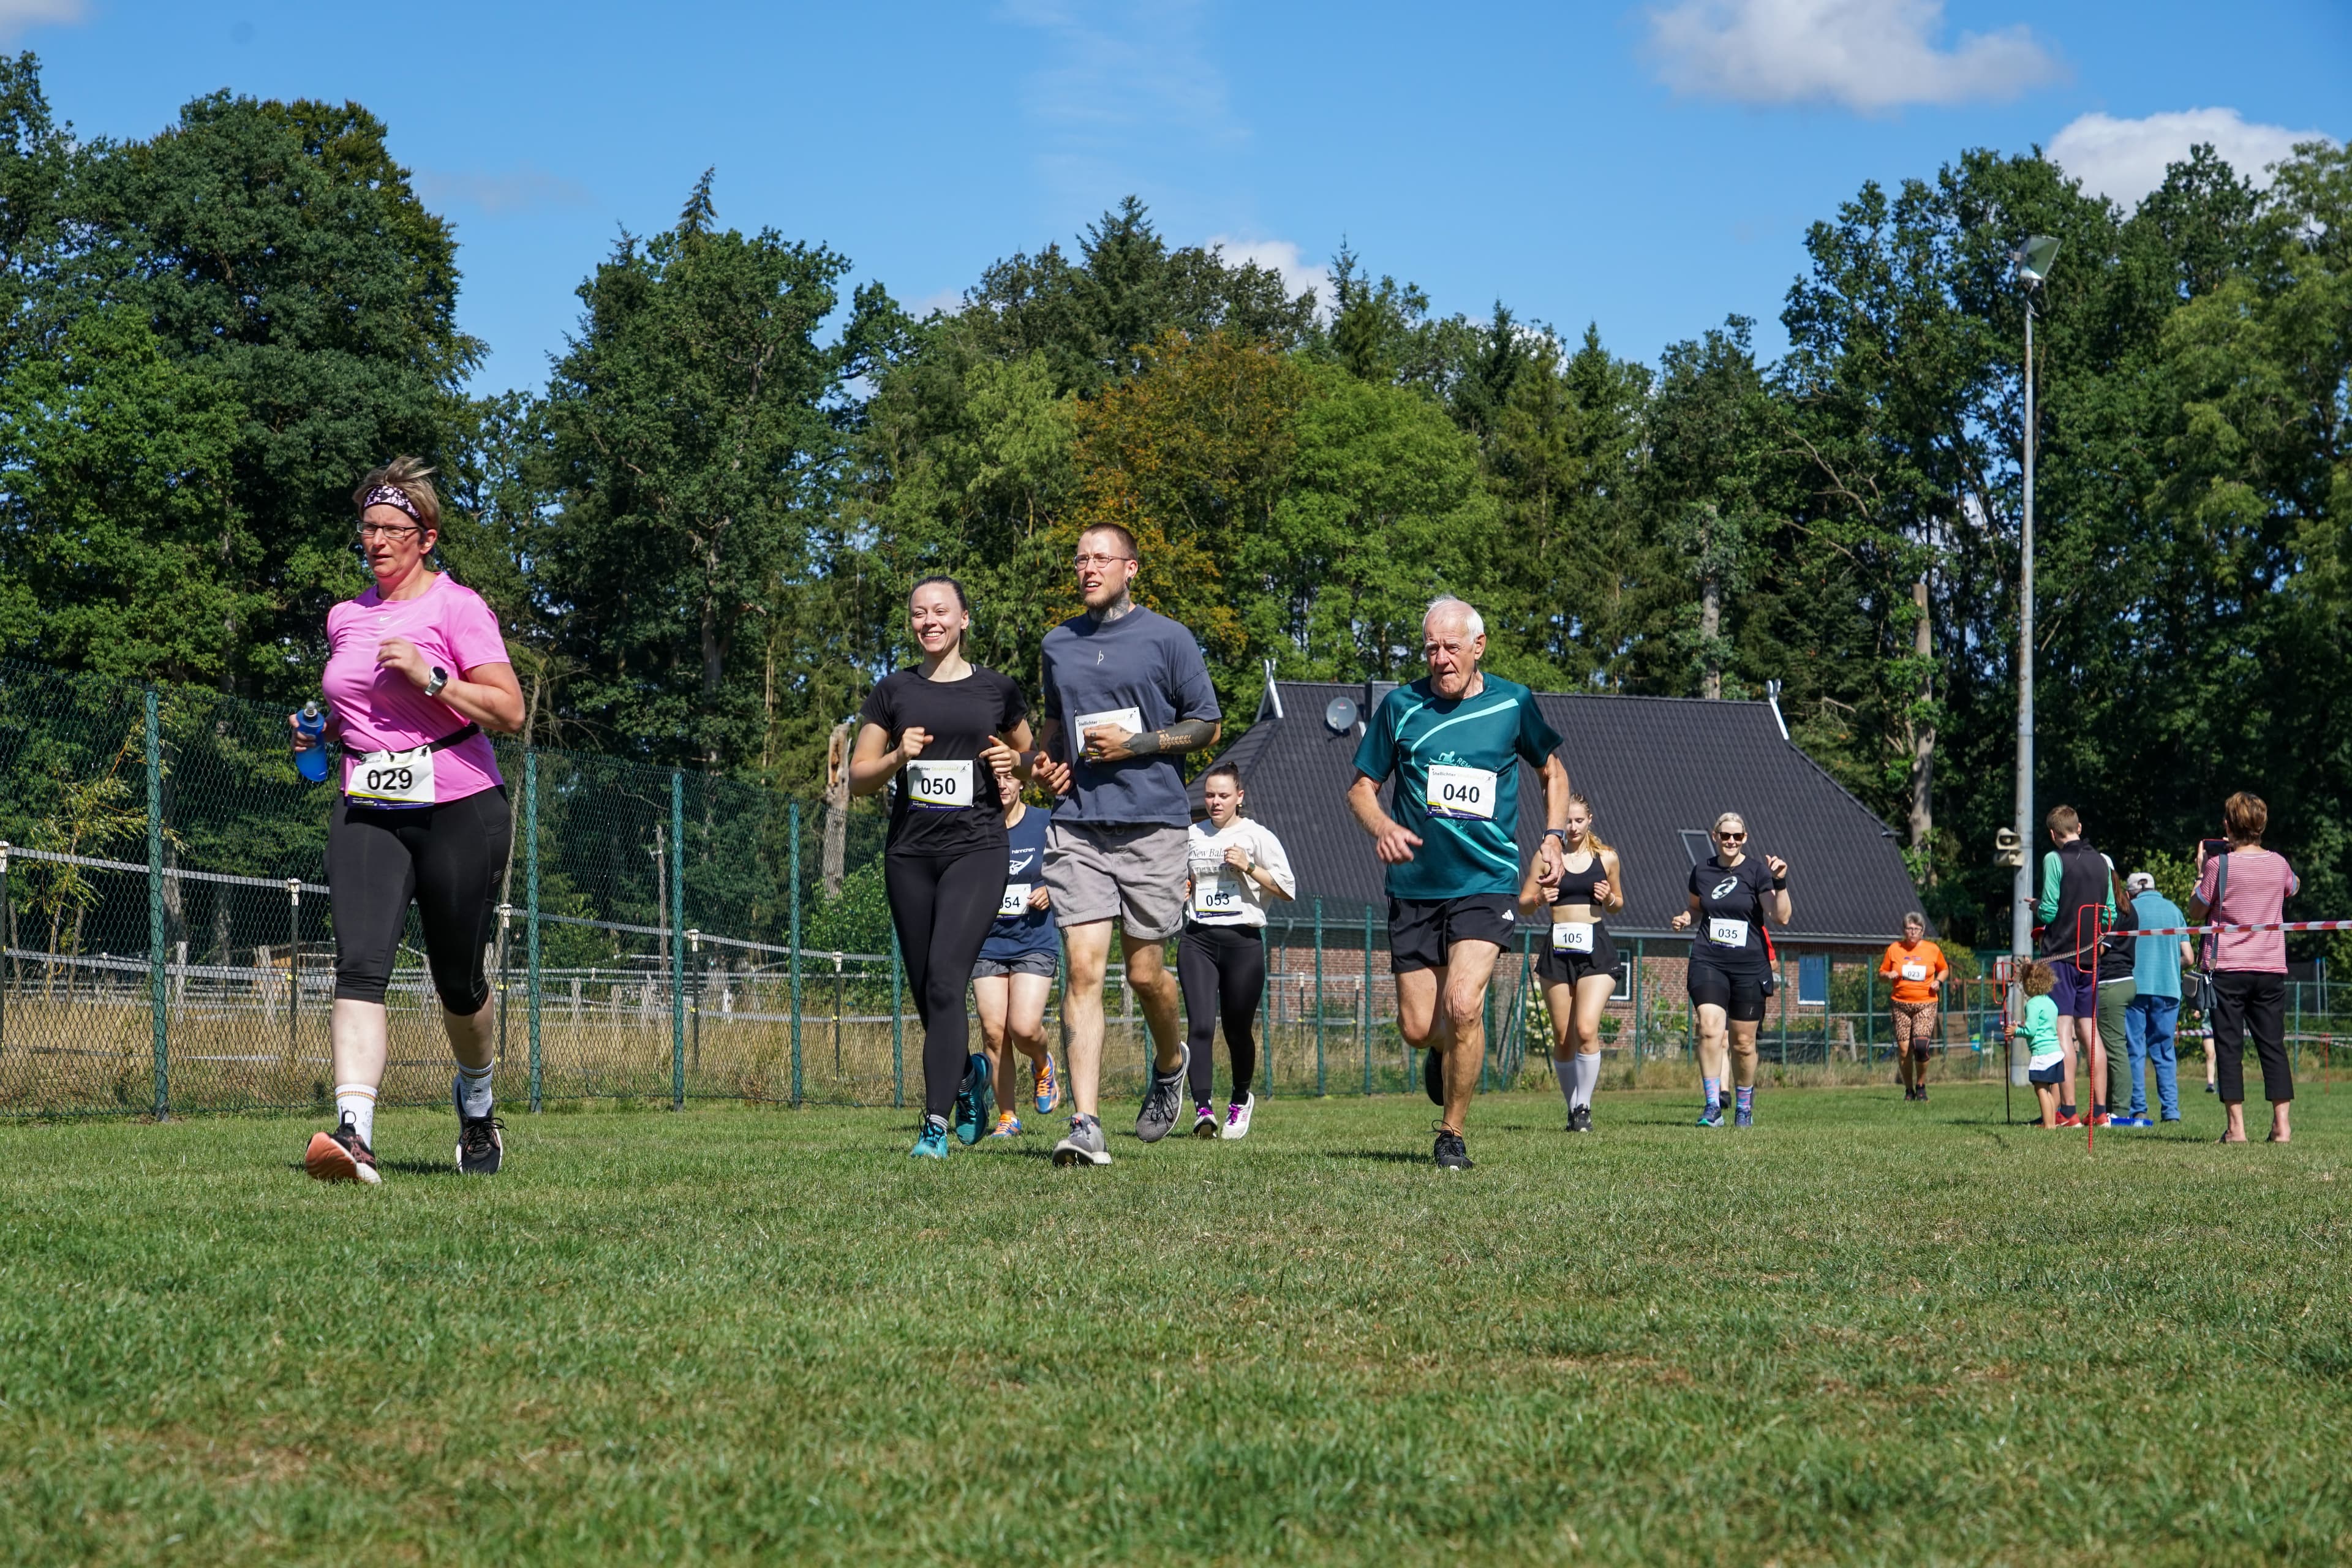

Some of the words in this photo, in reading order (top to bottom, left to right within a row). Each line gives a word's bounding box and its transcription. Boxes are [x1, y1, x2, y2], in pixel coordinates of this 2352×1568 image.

[1457, 757, 1473, 769] REM
[368, 769, 412, 790] 029
[921, 778, 956, 795] 050
[1444, 783, 1480, 803] 040
[1209, 848, 1225, 858] Bala
[1206, 893, 1230, 907] 053
[1563, 933, 1582, 943] 105
[1718, 929, 1738, 938] 035
